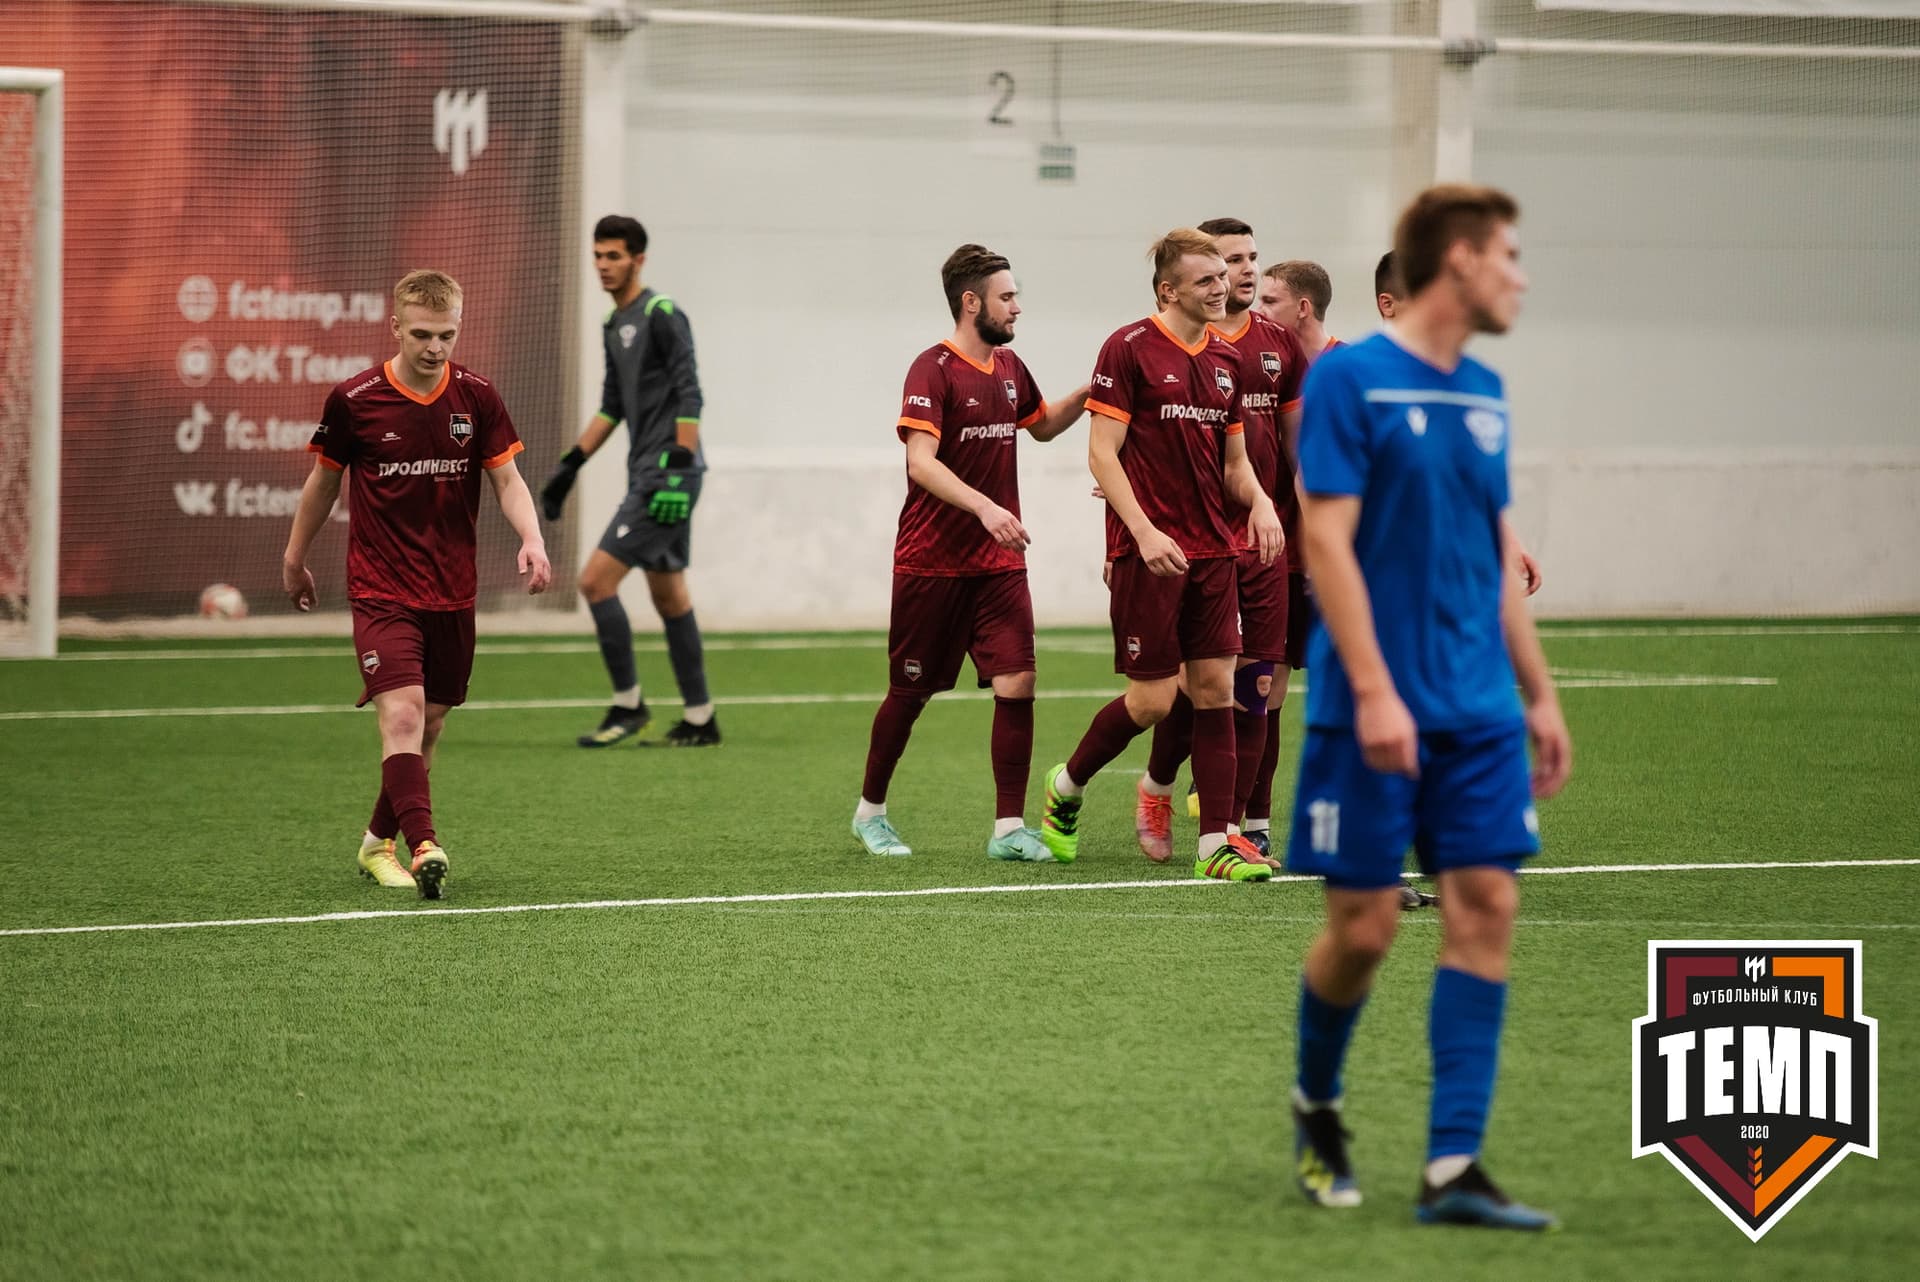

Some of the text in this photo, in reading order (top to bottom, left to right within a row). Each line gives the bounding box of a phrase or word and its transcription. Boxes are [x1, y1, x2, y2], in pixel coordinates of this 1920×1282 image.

[988, 70, 1015, 125] 2
[228, 279, 385, 330] fctemp.ru
[226, 345, 280, 384] ФК
[908, 395, 931, 408] ПСБ
[378, 457, 469, 477] ПРОДИНВЕСТ
[1309, 799, 1339, 854] 11
